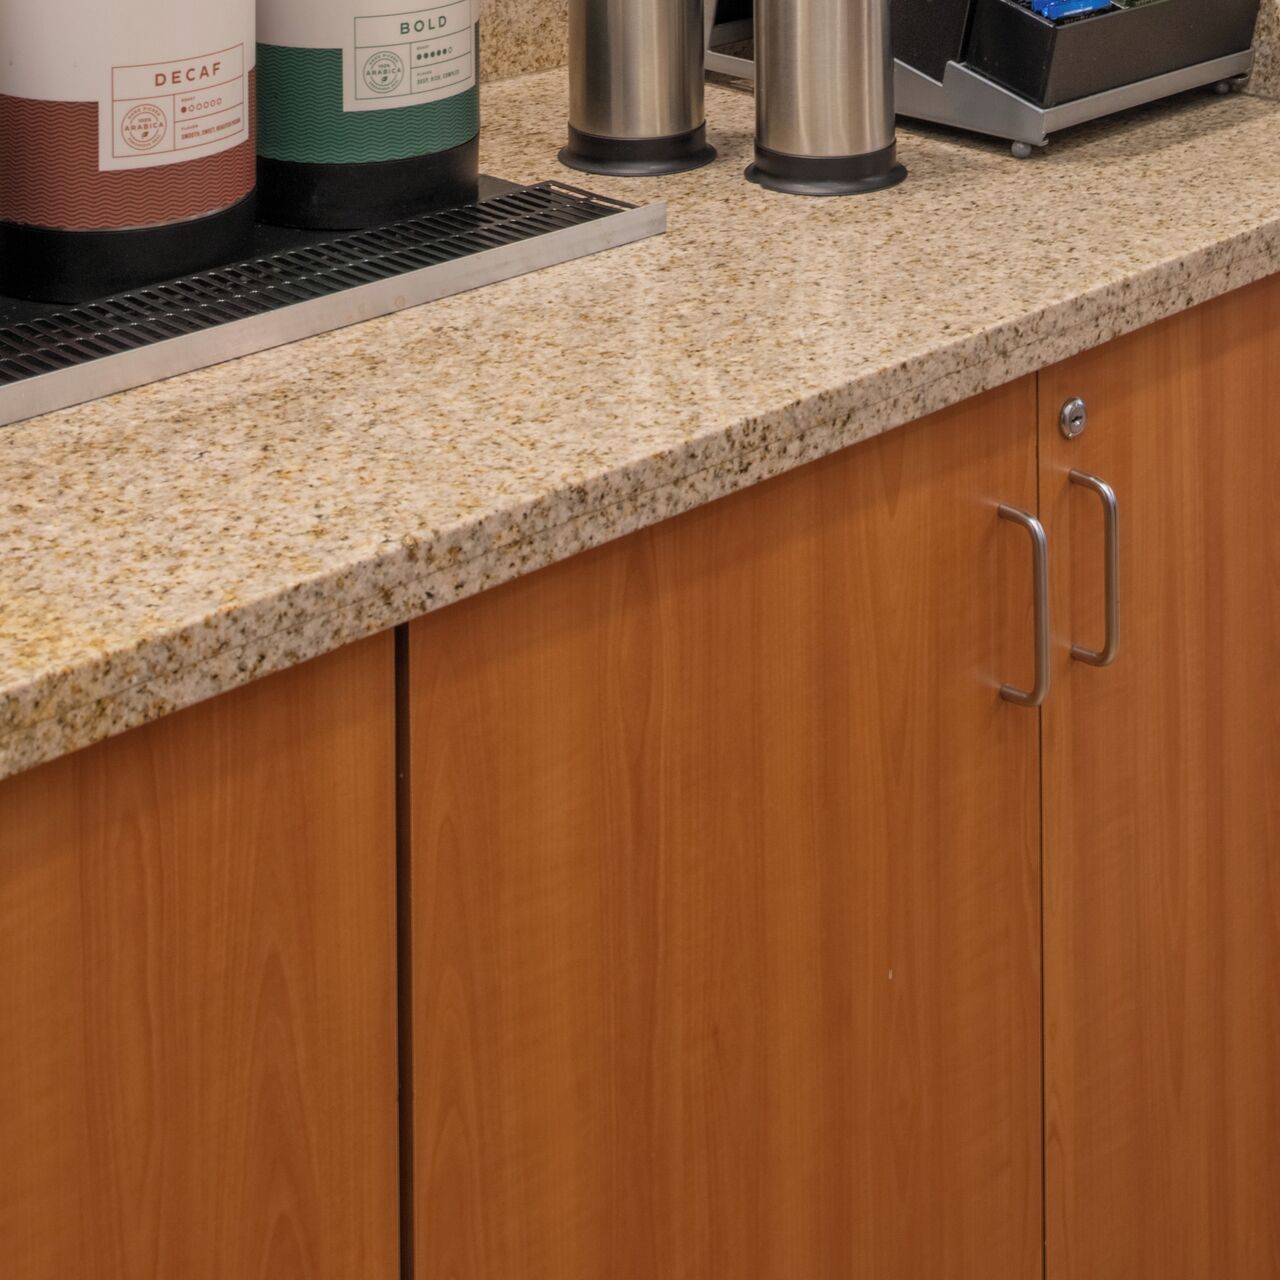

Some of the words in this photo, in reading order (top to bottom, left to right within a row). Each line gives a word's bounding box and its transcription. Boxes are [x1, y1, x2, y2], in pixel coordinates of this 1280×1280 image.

[400, 15, 447, 35] BOLD
[154, 62, 221, 87] DECAF
[366, 67, 402, 76] ARABICA
[124, 121, 164, 132] ARABICA
